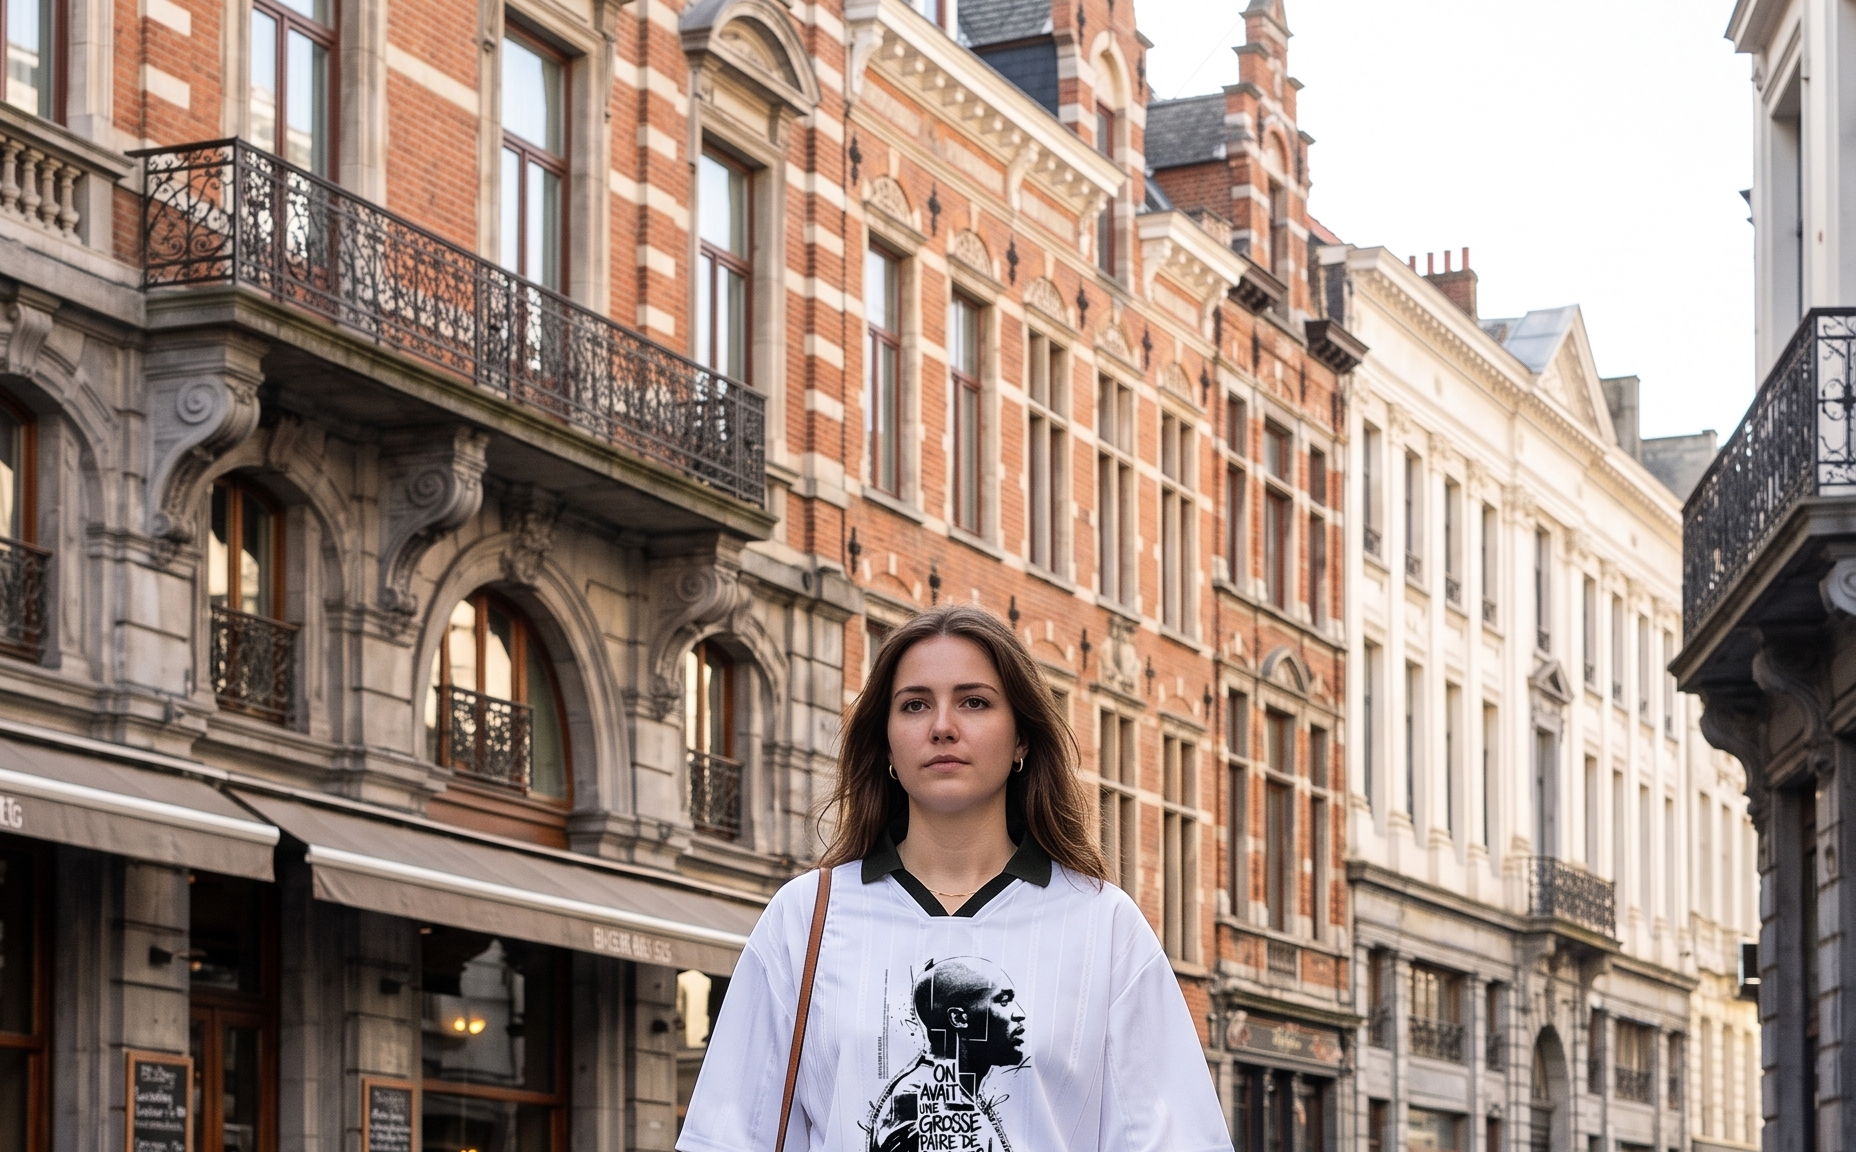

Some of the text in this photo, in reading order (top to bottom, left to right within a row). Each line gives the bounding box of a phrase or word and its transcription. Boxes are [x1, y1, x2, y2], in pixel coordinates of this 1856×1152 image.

[933, 1062, 956, 1083] ON
[919, 1102, 940, 1114] UNE
[919, 1112, 982, 1134] GROSSE
[920, 1134, 981, 1150] PAIRE DE
